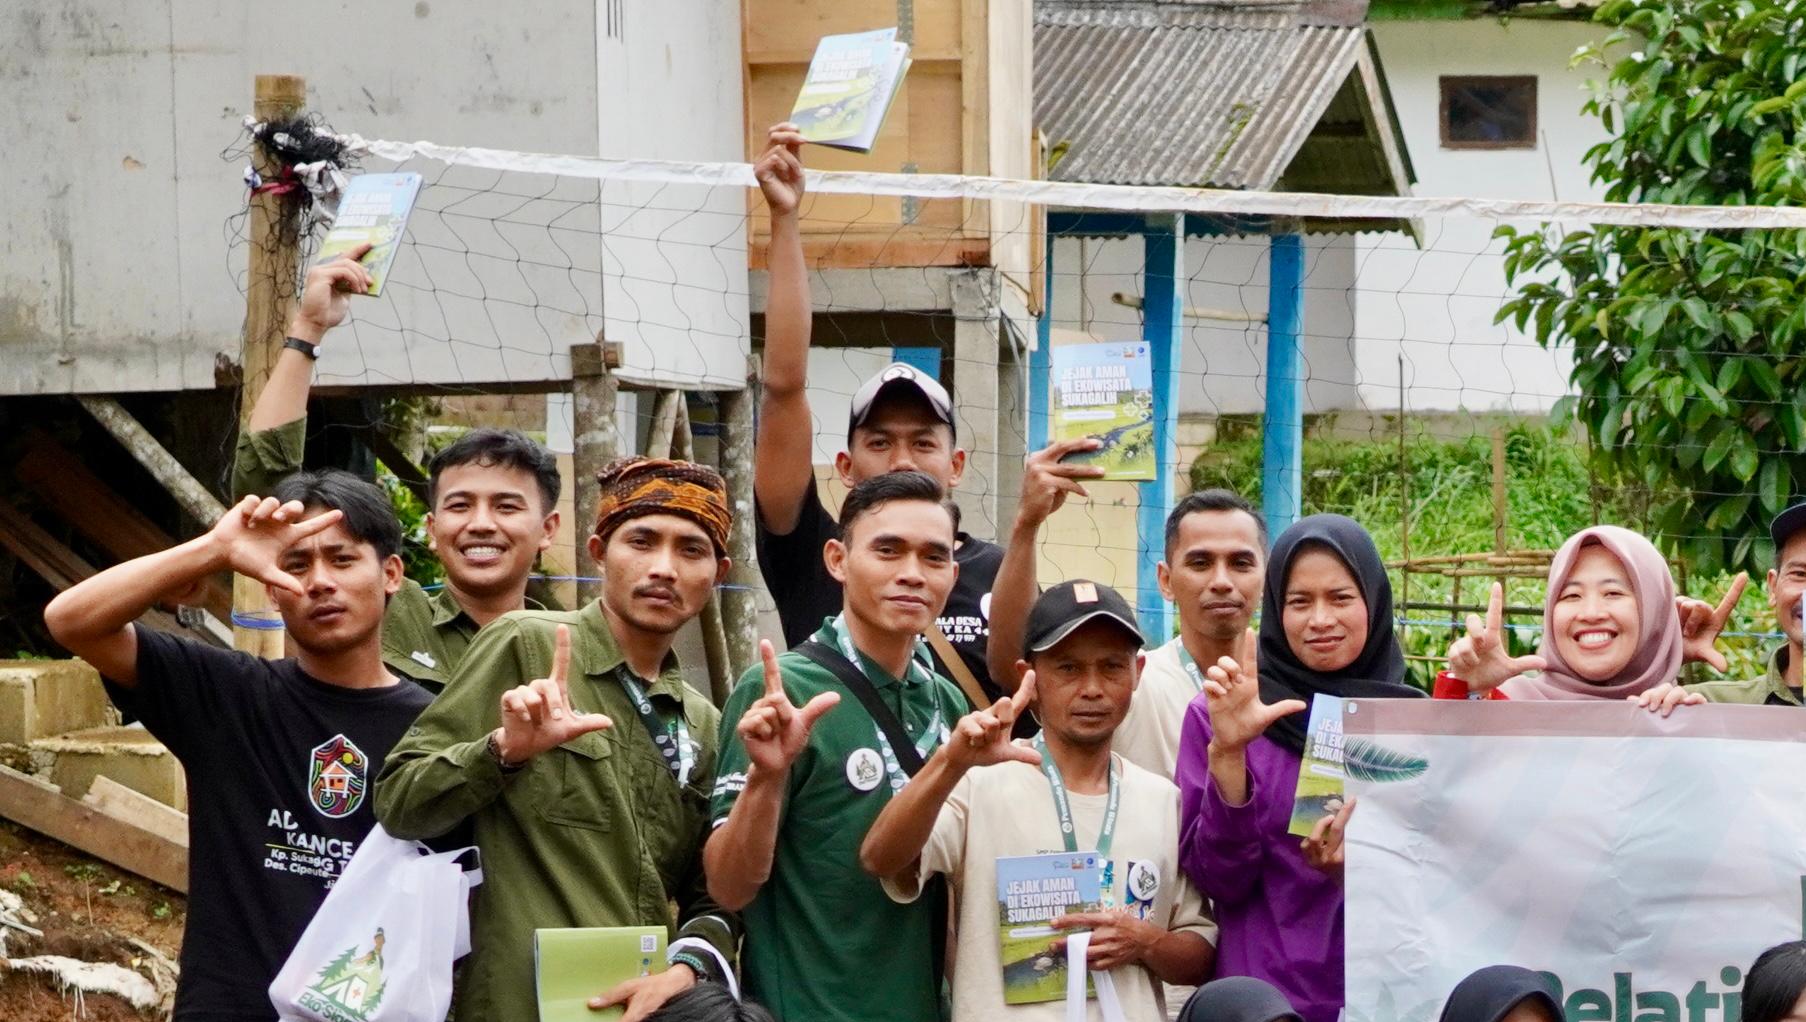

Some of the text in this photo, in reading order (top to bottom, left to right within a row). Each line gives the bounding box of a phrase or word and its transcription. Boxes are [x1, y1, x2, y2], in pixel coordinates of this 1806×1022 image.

[1007, 877, 1075, 895] JEJAK AMAN
[1007, 890, 1081, 909] DI EKOWISATA
[1008, 905, 1066, 923] SUKAGALIH
[298, 991, 322, 1012] Eko
